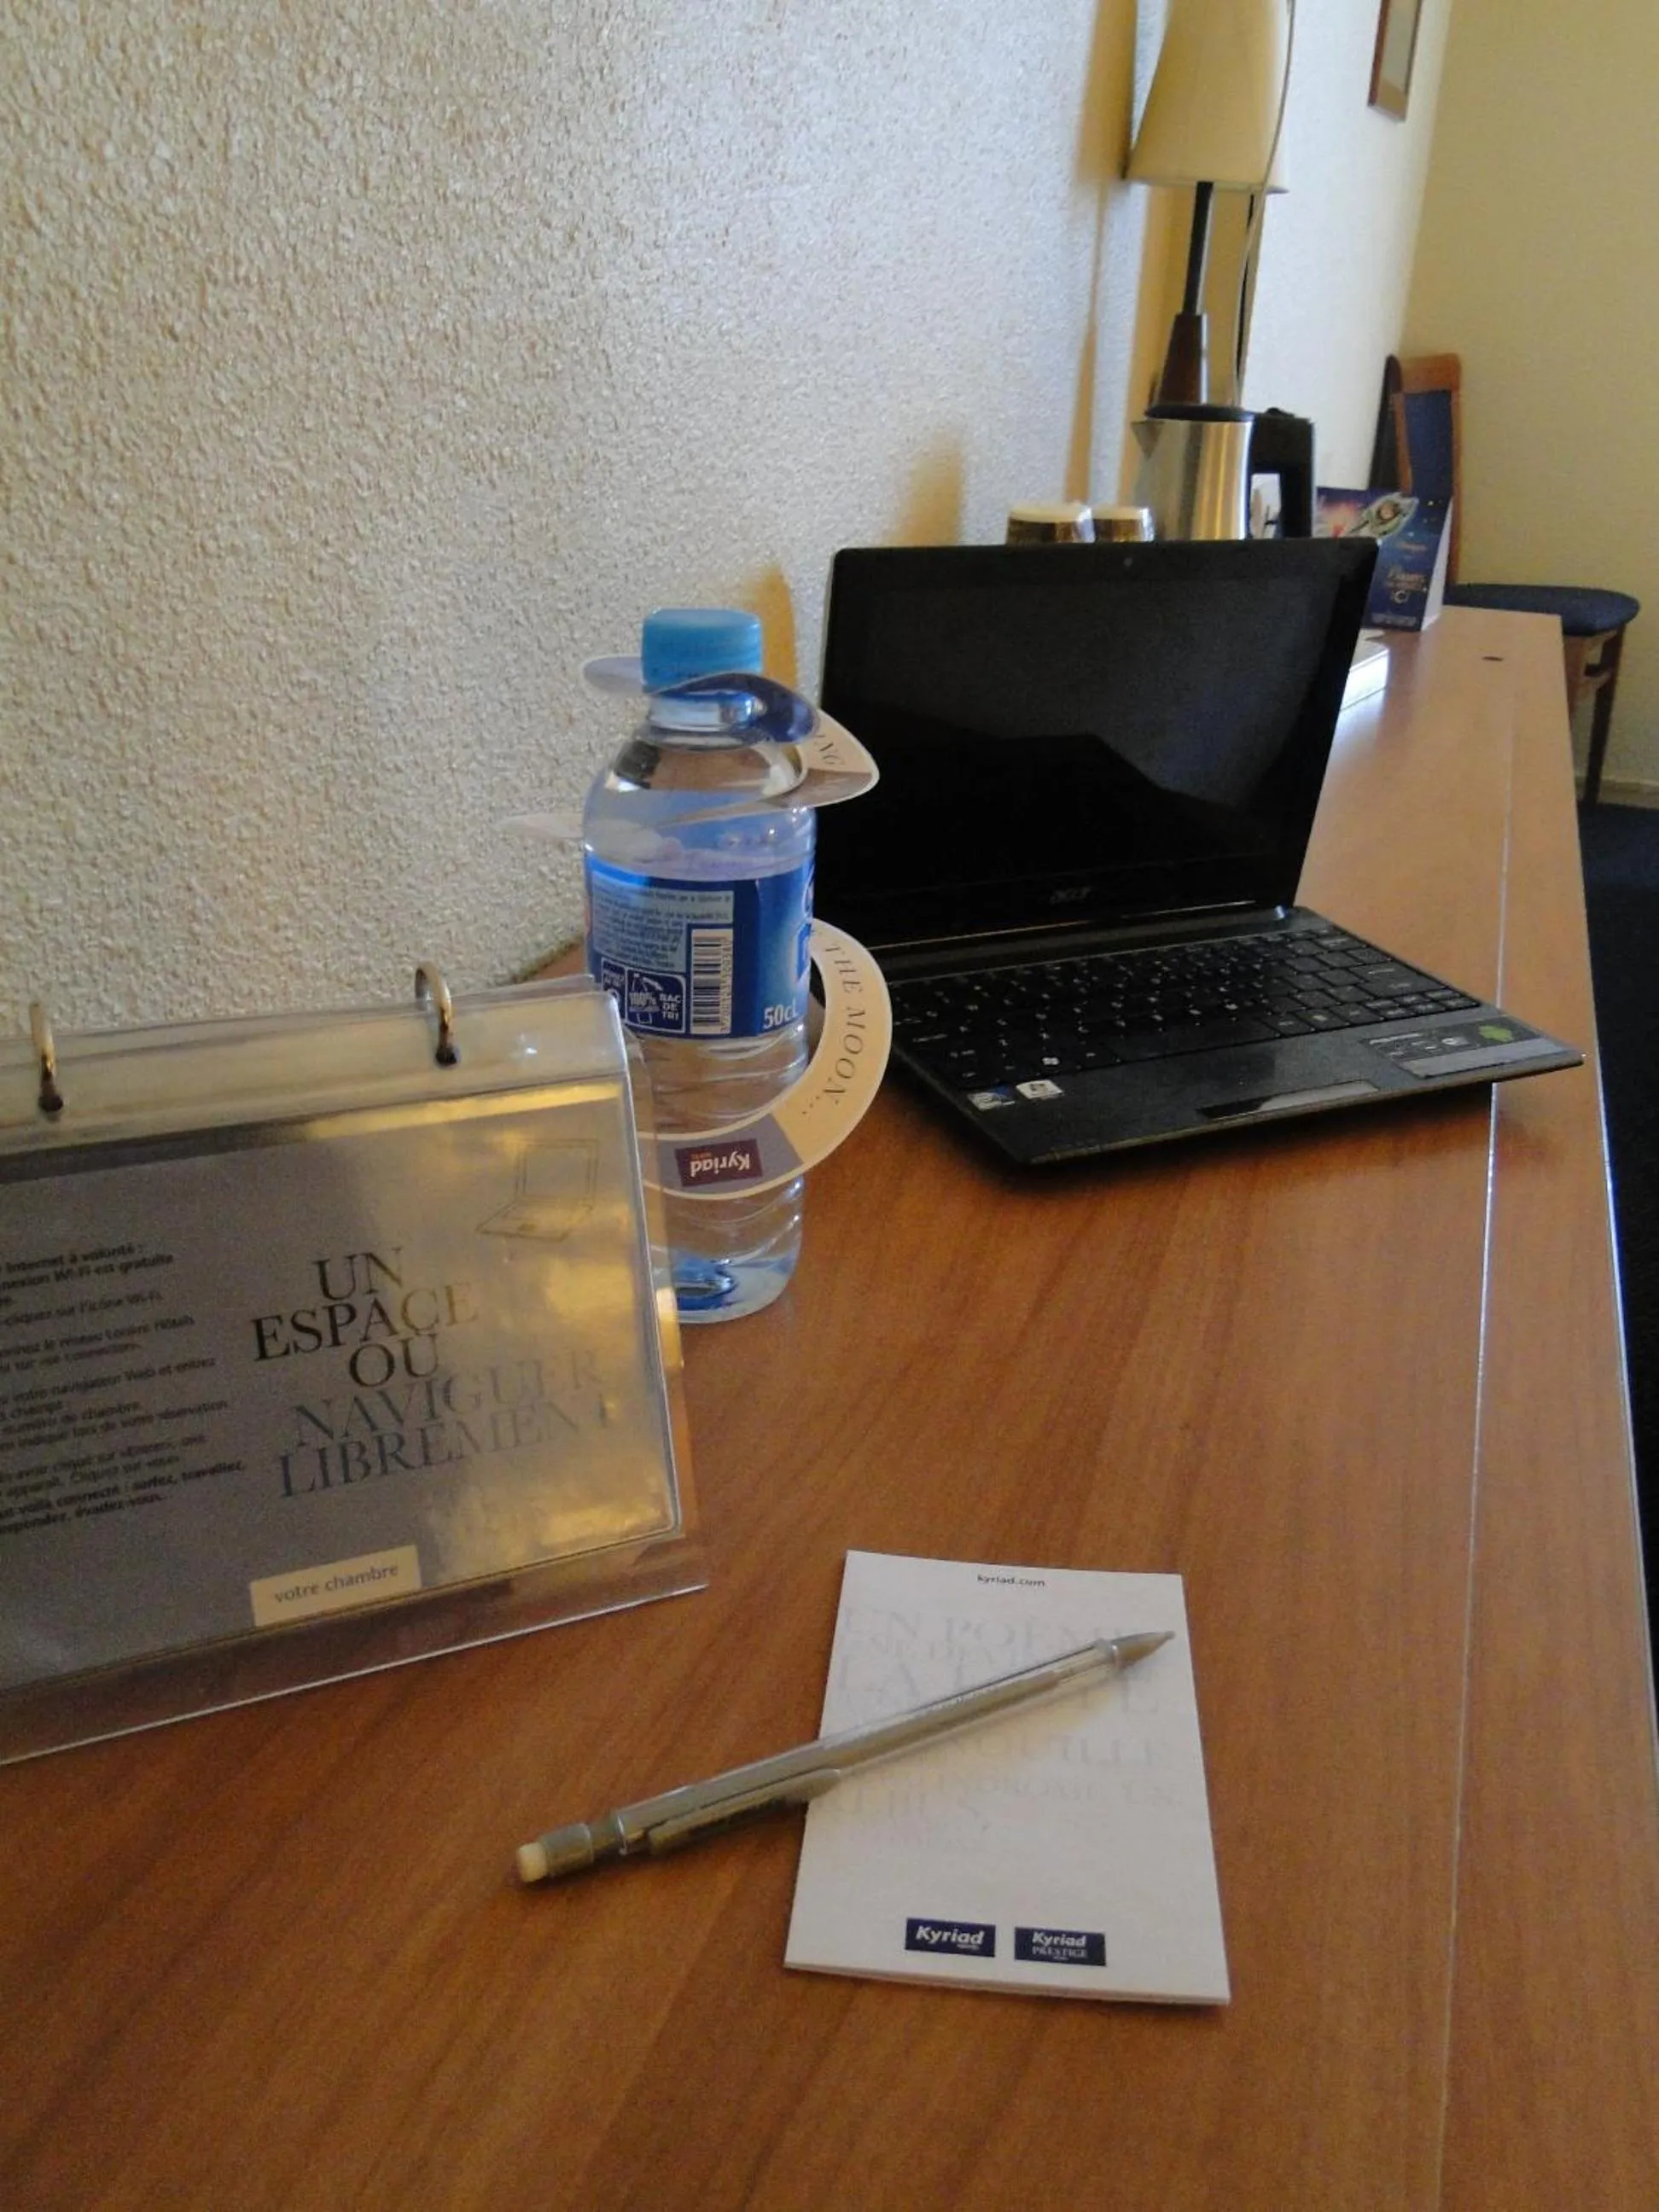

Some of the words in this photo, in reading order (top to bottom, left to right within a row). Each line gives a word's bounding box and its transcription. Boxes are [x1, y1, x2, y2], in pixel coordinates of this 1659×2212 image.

[690, 1150, 751, 1178] Kyriad
[312, 1246, 403, 1303] UN
[253, 1284, 478, 1362] ESPACE
[349, 1332, 439, 1388] OU
[274, 1580, 320, 1604] votre
[324, 1562, 399, 1593] chambre
[915, 1924, 984, 1946] Kyriad
[1032, 1931, 1087, 1947] Kyriad
[1032, 1945, 1088, 1958] PRESTIGE
